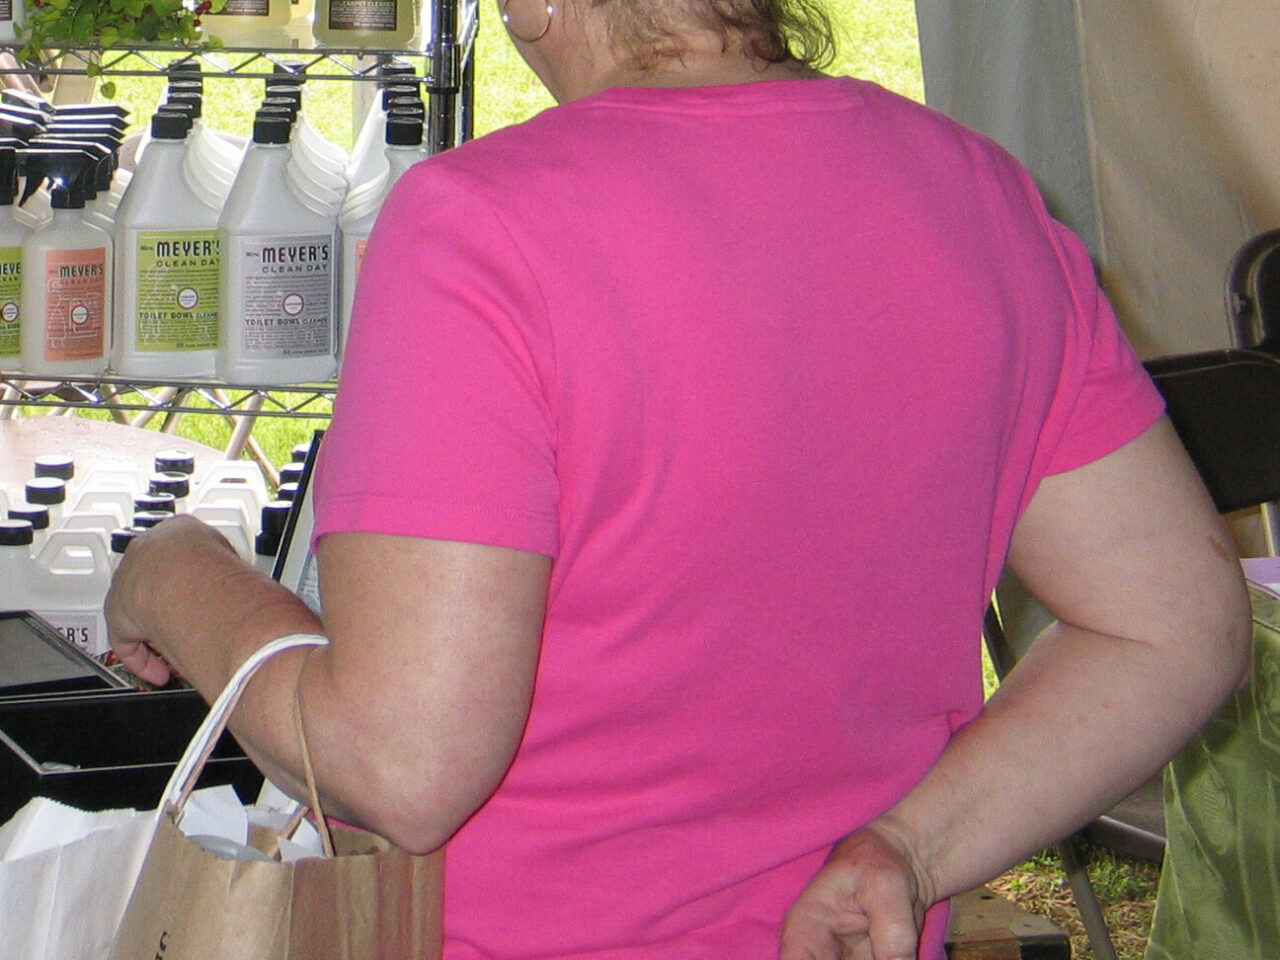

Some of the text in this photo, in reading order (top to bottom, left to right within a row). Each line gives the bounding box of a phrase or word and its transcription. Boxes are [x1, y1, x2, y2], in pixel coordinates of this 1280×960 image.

[262, 244, 329, 264] MEYER'S
[156, 258, 197, 267] CLEAN
[60, 263, 104, 278] MEYER'S
[262, 264, 328, 274] CLEAN DAY
[139, 312, 168, 320] TOILET
[170, 312, 194, 320] BOWL
[245, 318, 275, 326] TOILET
[277, 318, 300, 326] BOWL
